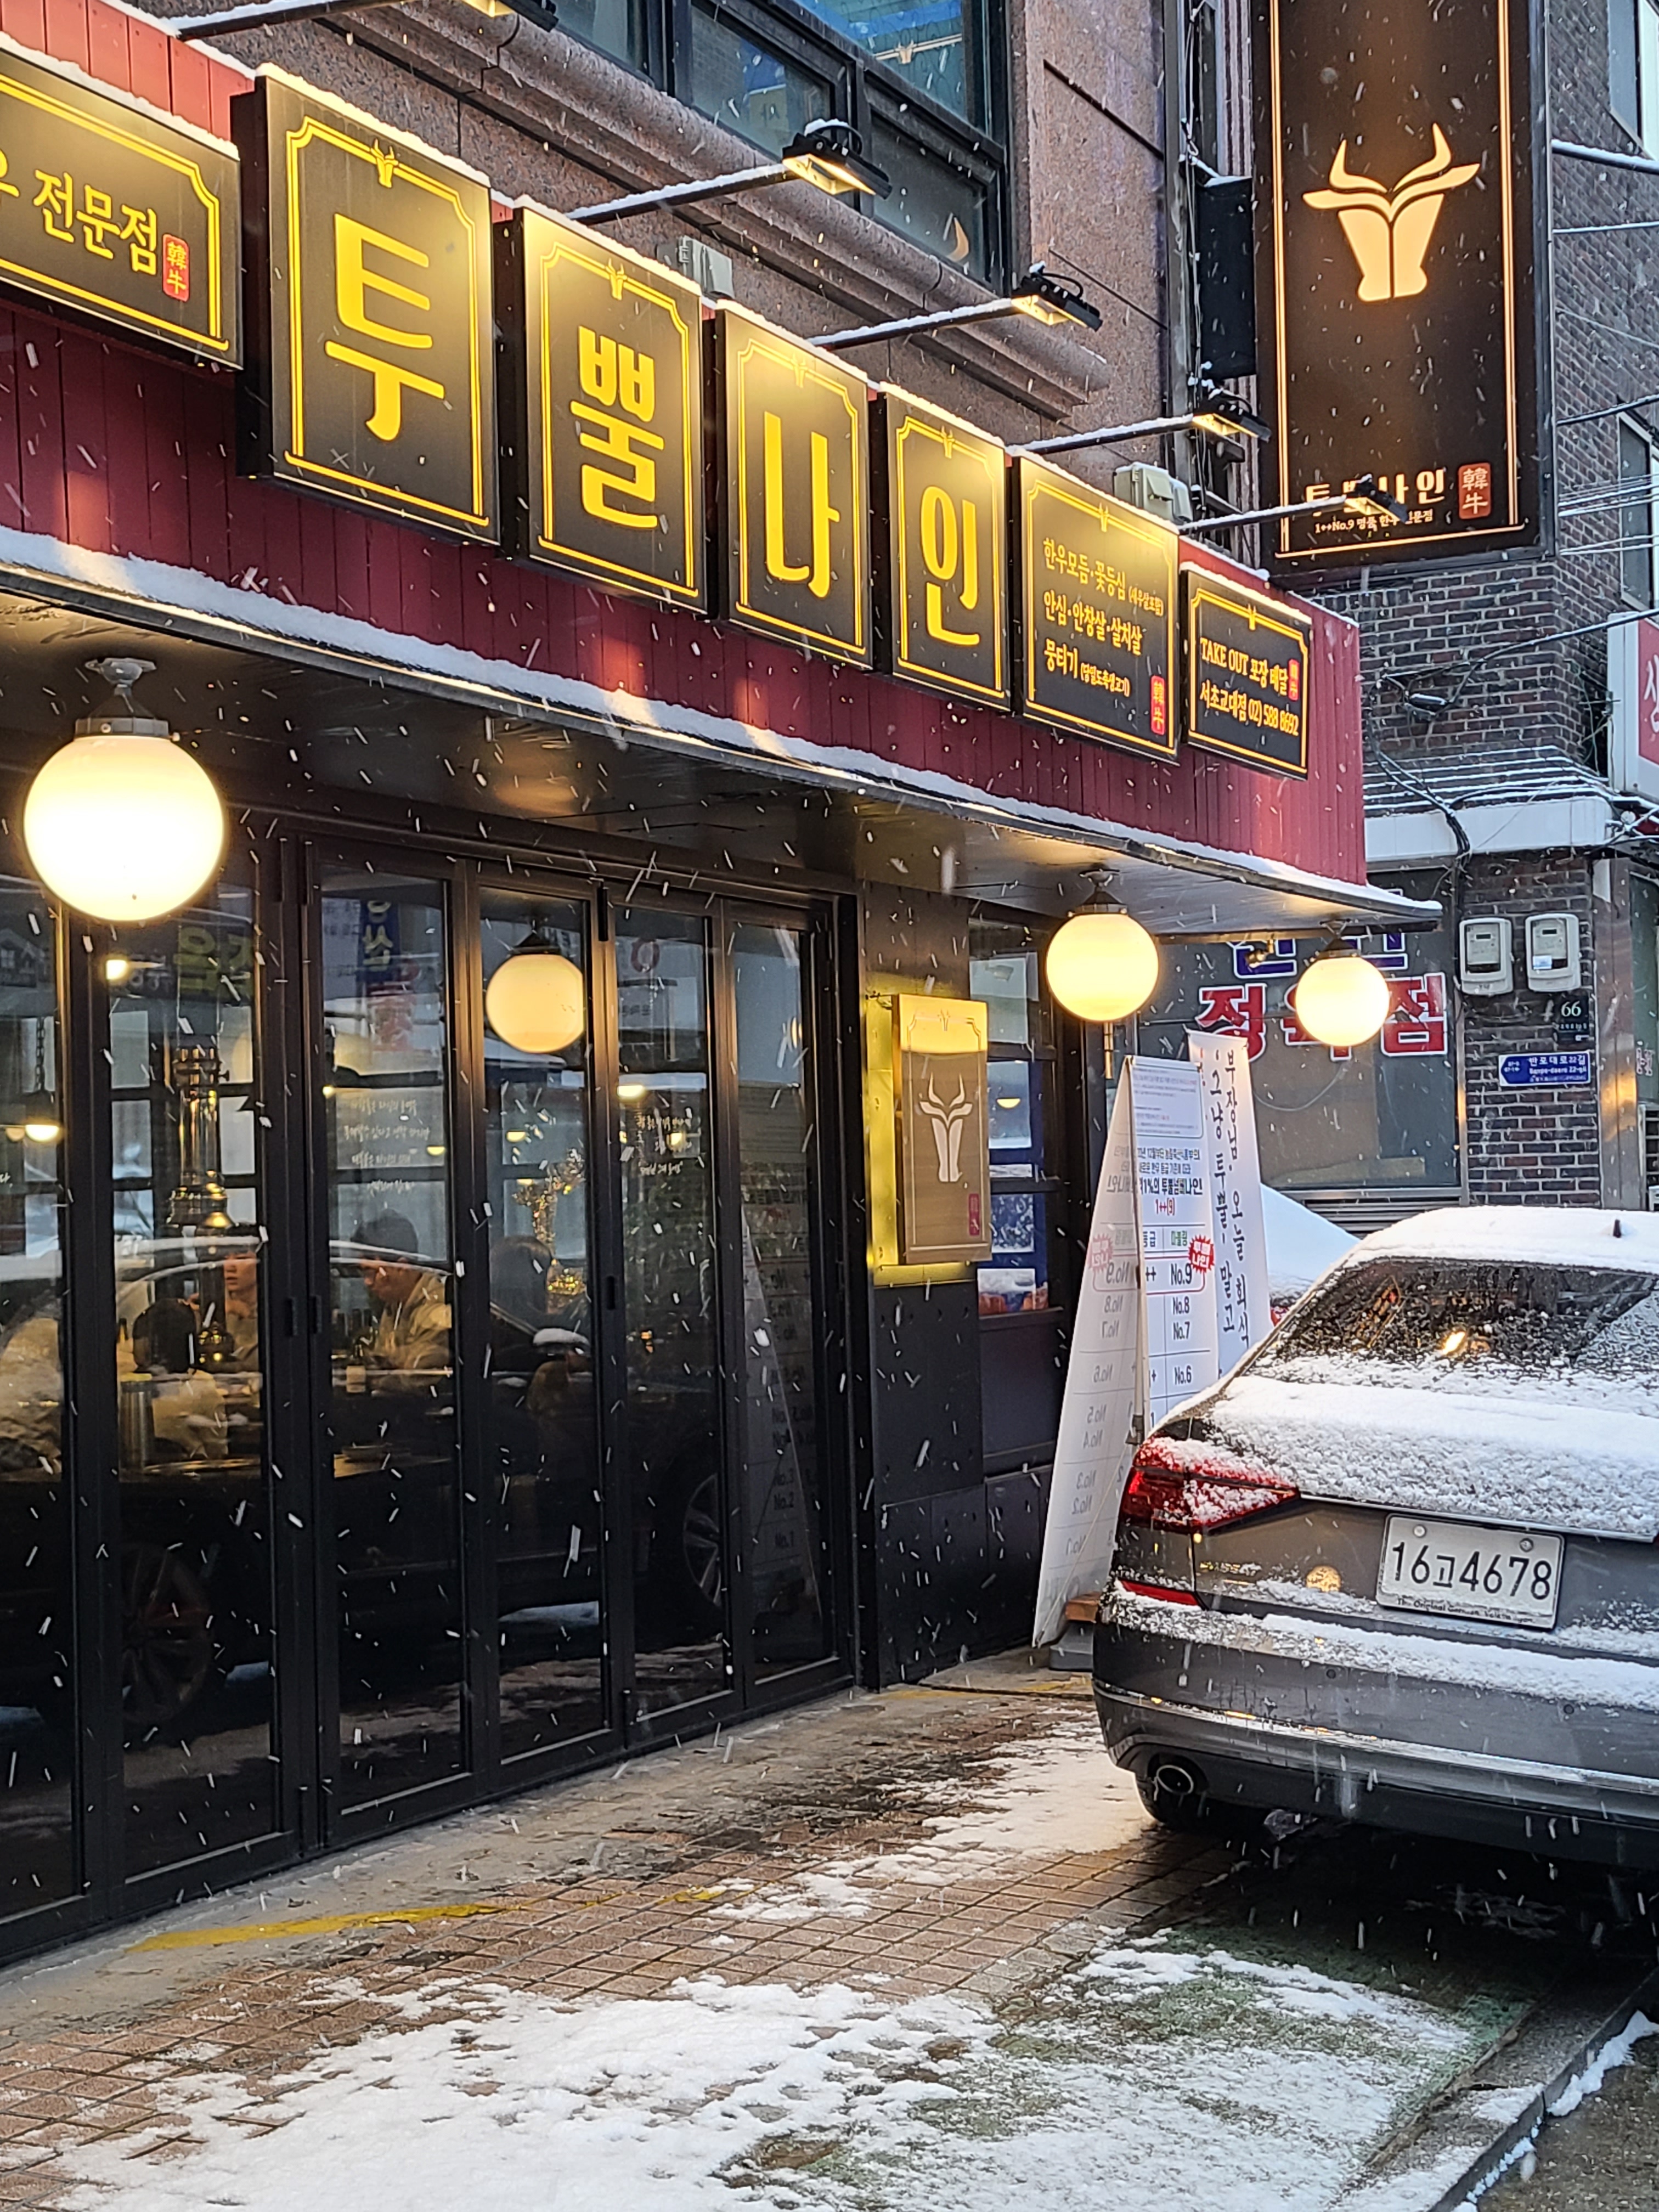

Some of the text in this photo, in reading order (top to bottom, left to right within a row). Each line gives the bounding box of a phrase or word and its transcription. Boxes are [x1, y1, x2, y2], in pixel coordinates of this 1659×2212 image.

[33, 169, 157, 275] 전문점
[166, 241, 188, 295] 韓牛
[1305, 468, 1446, 517] 투나인
[1461, 467, 1489, 515] 韓牛
[1043, 638, 1079, 679] 뭉티기
[1199, 636, 1289, 696] TAKE OUT 포장 배달
[1199, 678, 1299, 737] 서초교대점 02) 588 8692
[1195, 973, 1448, 1062] 정점
[1561, 1000, 1582, 1017] 66
[1232, 1190, 1245, 1261] 오늘
[1170, 1263, 1193, 1286] No.9
[1219, 1260, 1234, 1332] 말고
[1172, 1296, 1190, 1315] No.8
[1172, 1321, 1190, 1340] No.7
[1237, 1273, 1250, 1349] 회식
[1174, 1364, 1192, 1385] No.6
[1392, 1542, 1552, 1600] 16고4678
